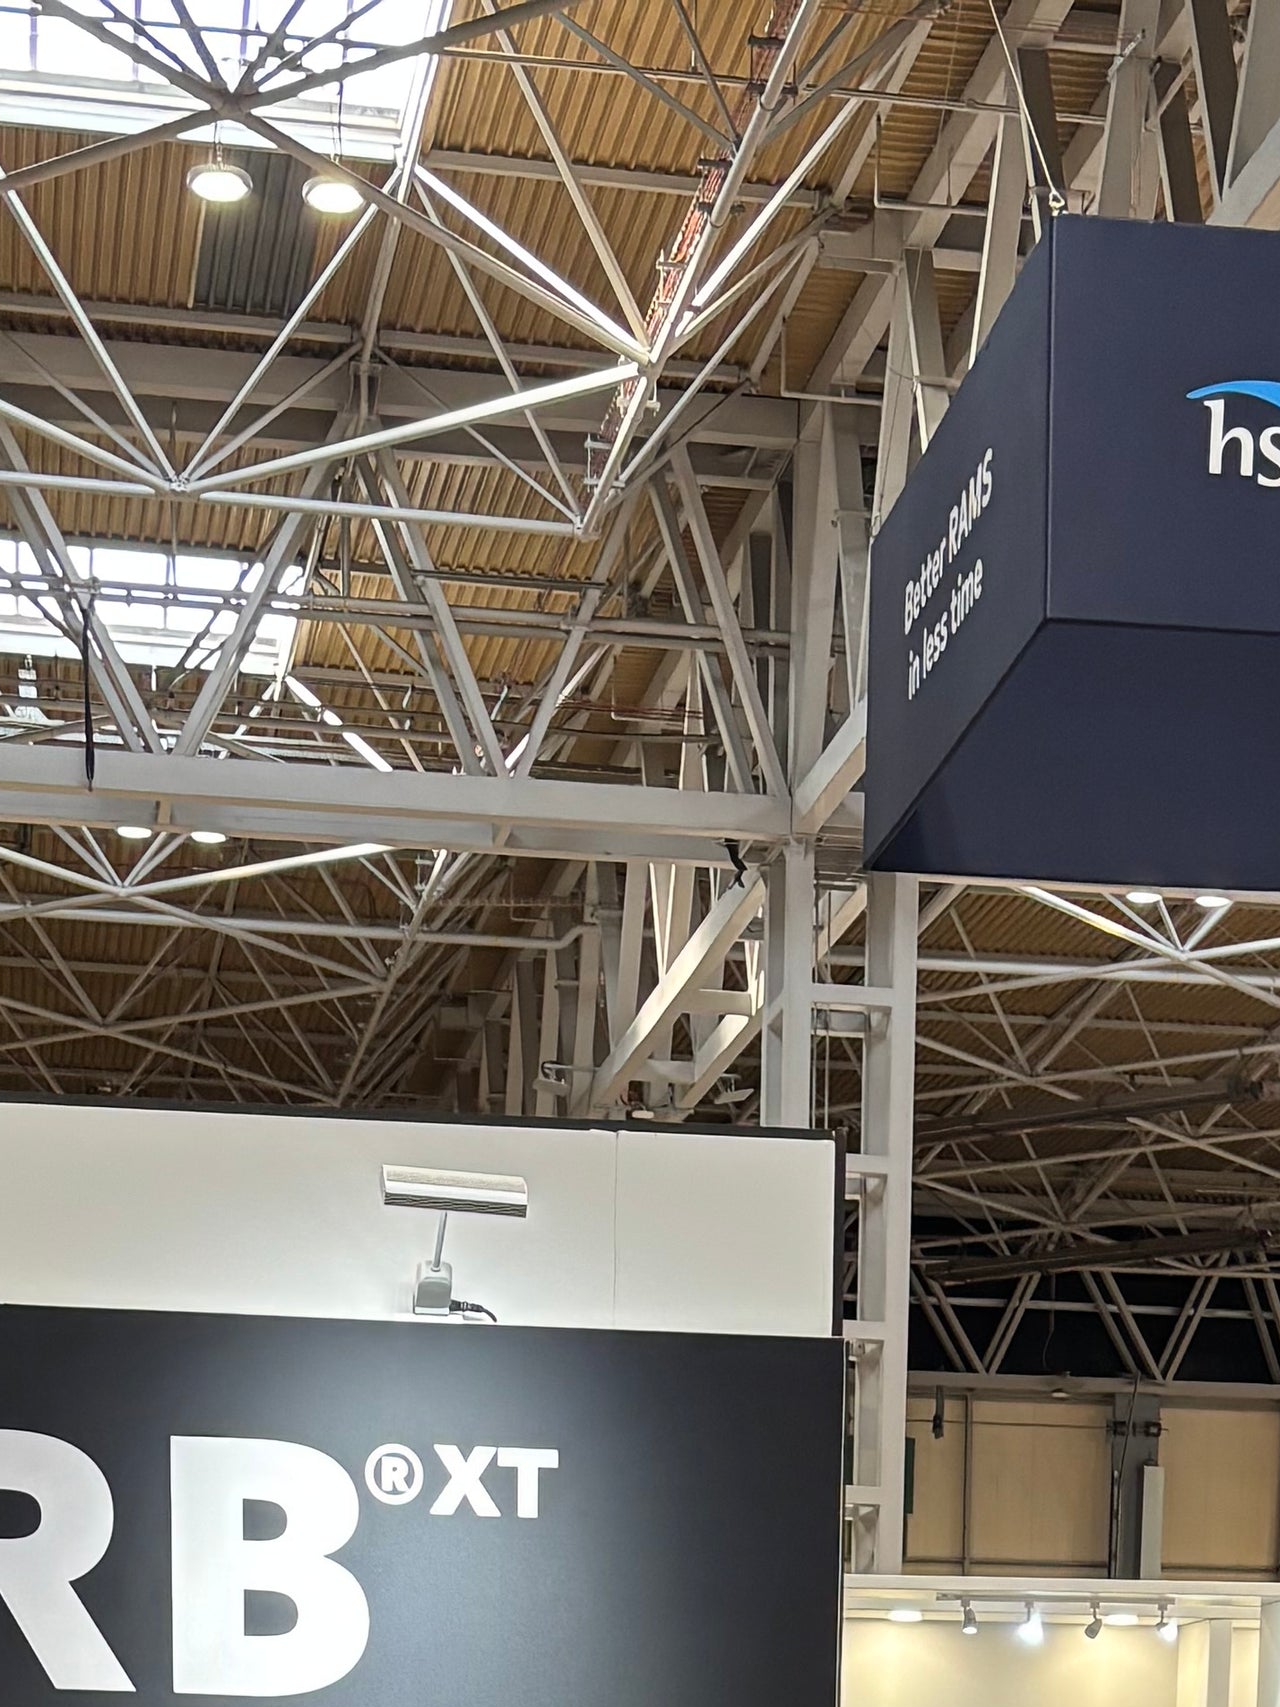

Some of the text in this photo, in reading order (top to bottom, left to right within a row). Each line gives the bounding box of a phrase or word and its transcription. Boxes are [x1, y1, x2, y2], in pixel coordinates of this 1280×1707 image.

[903, 447, 994, 636] Better RAMS
[907, 558, 983, 701] in less time
